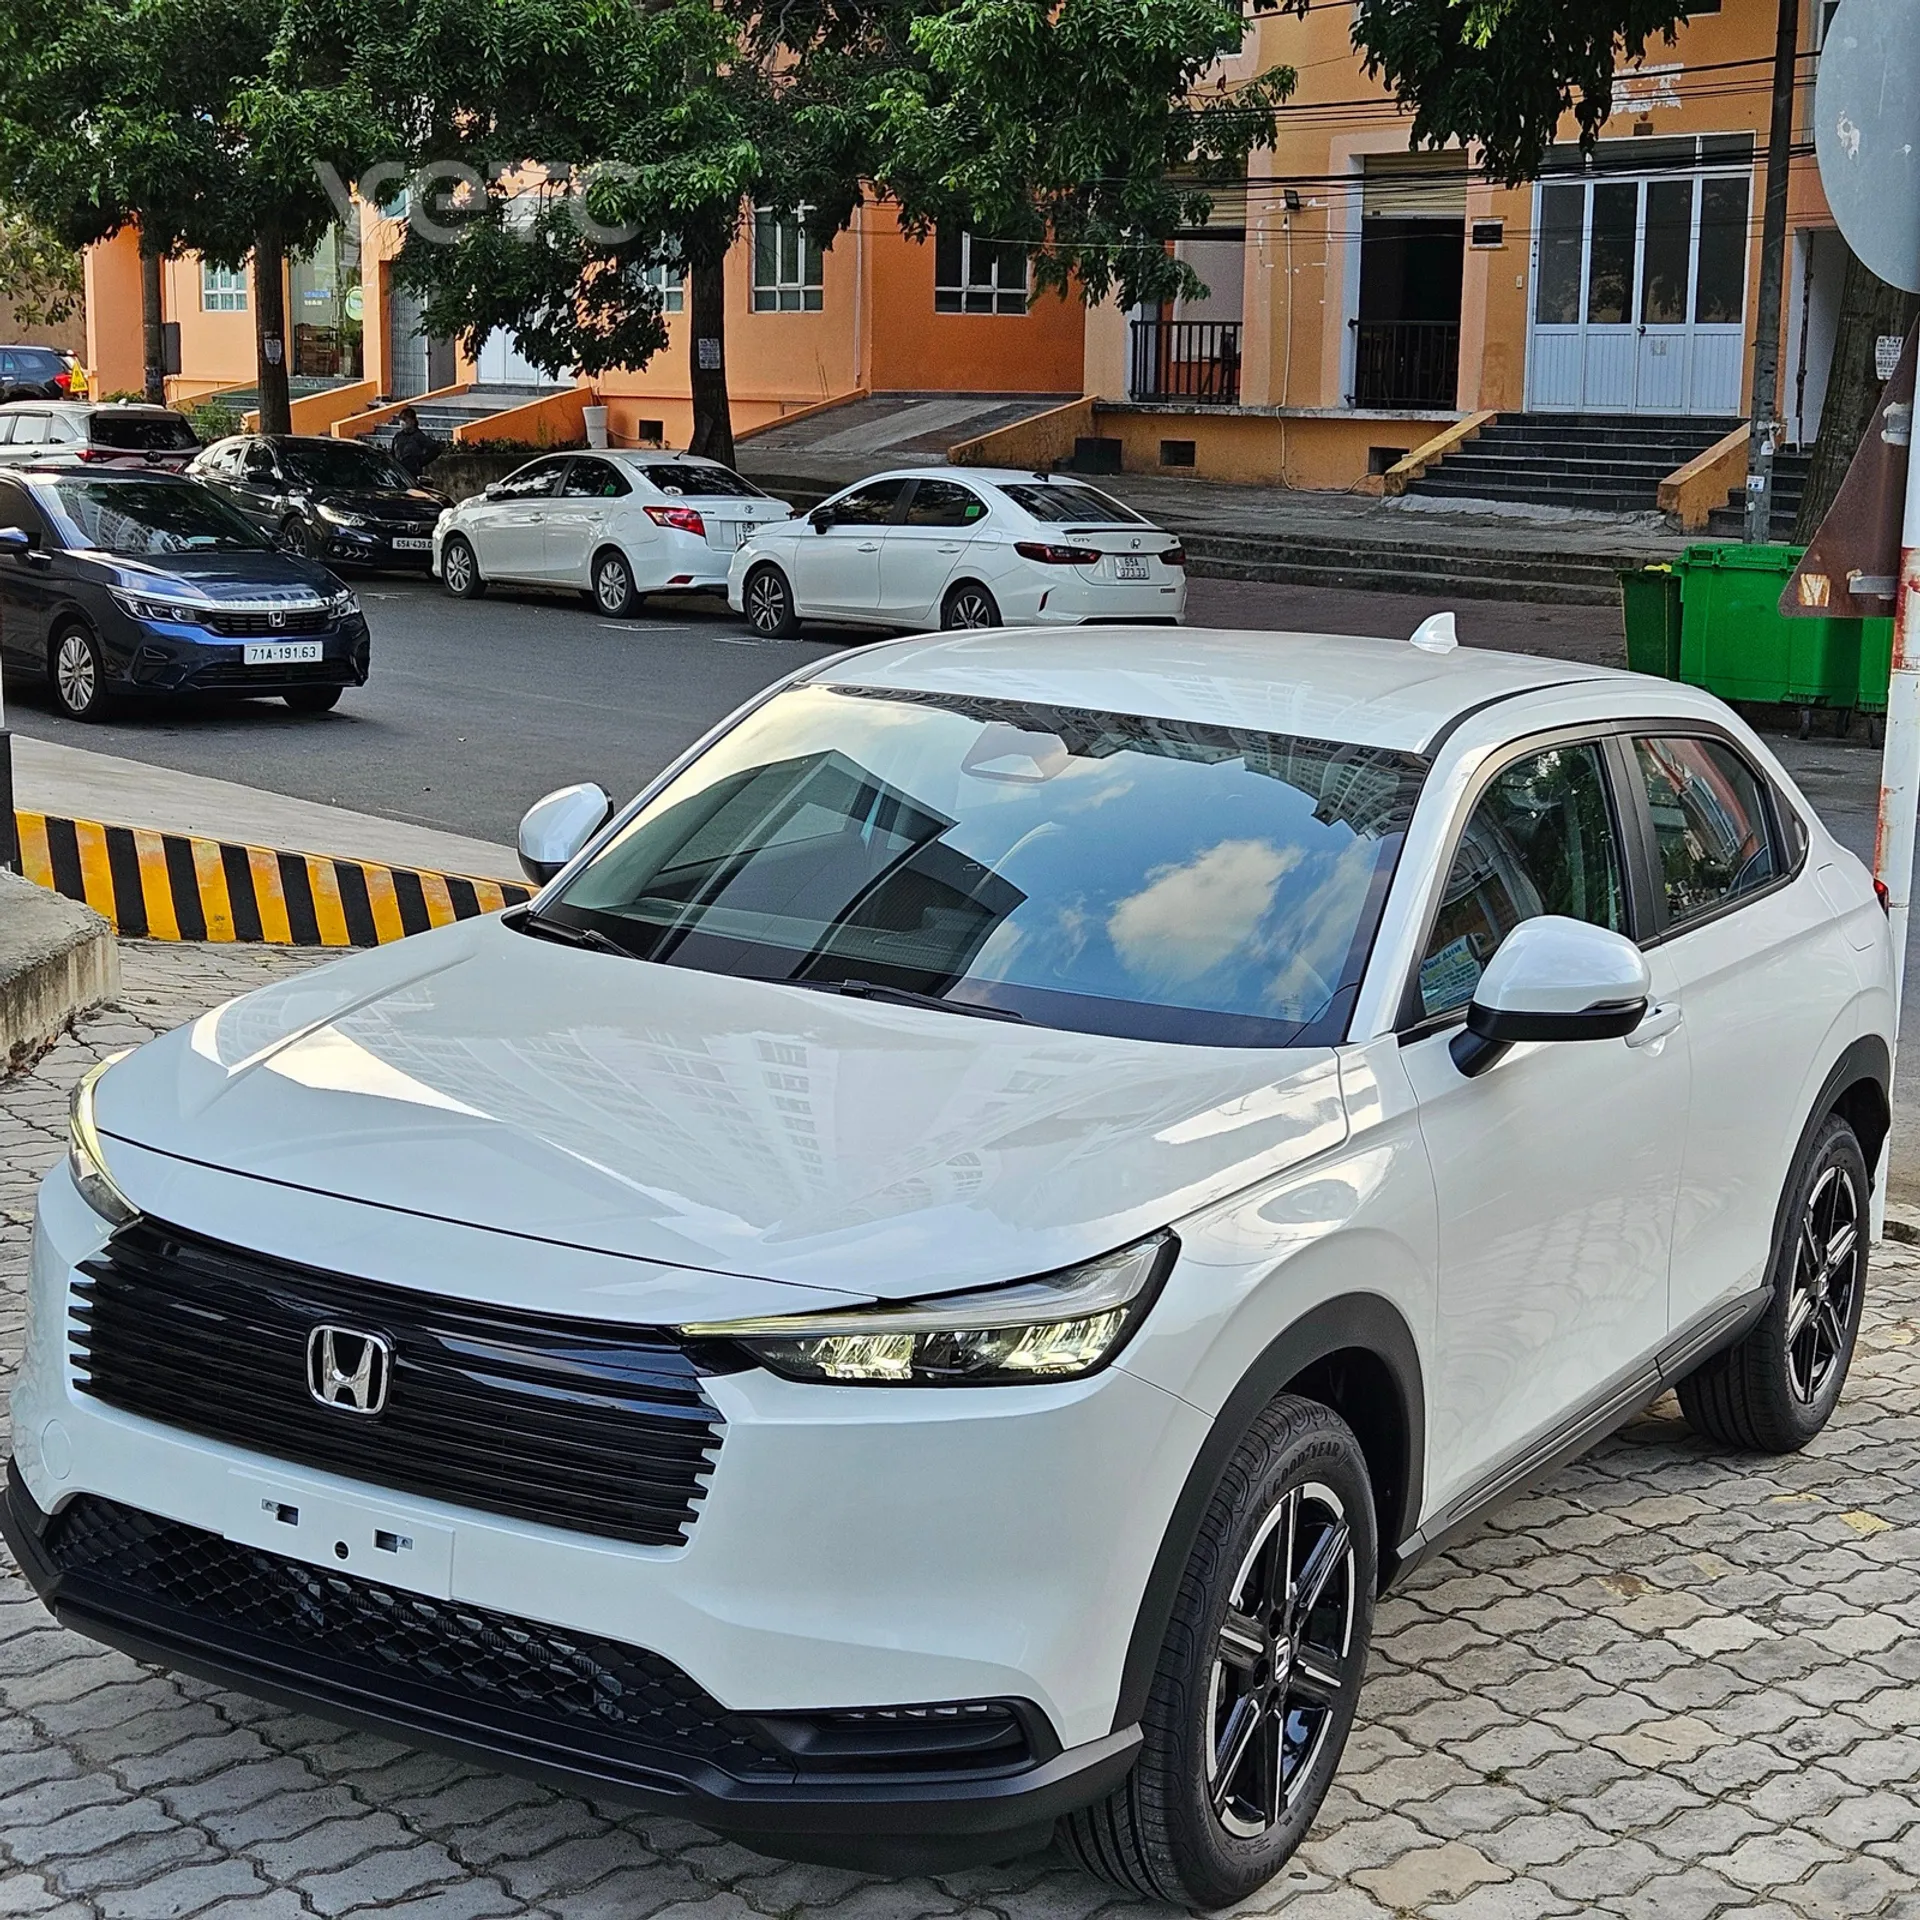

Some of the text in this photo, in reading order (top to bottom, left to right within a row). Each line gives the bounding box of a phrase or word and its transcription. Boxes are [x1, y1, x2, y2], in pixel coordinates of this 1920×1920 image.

[396, 540, 433, 549] 65A-439.0
[1124, 557, 1139, 567] 65A
[251, 646, 317, 660] 71A-191.63
[1272, 1441, 1341, 1495] GOODYEAR
